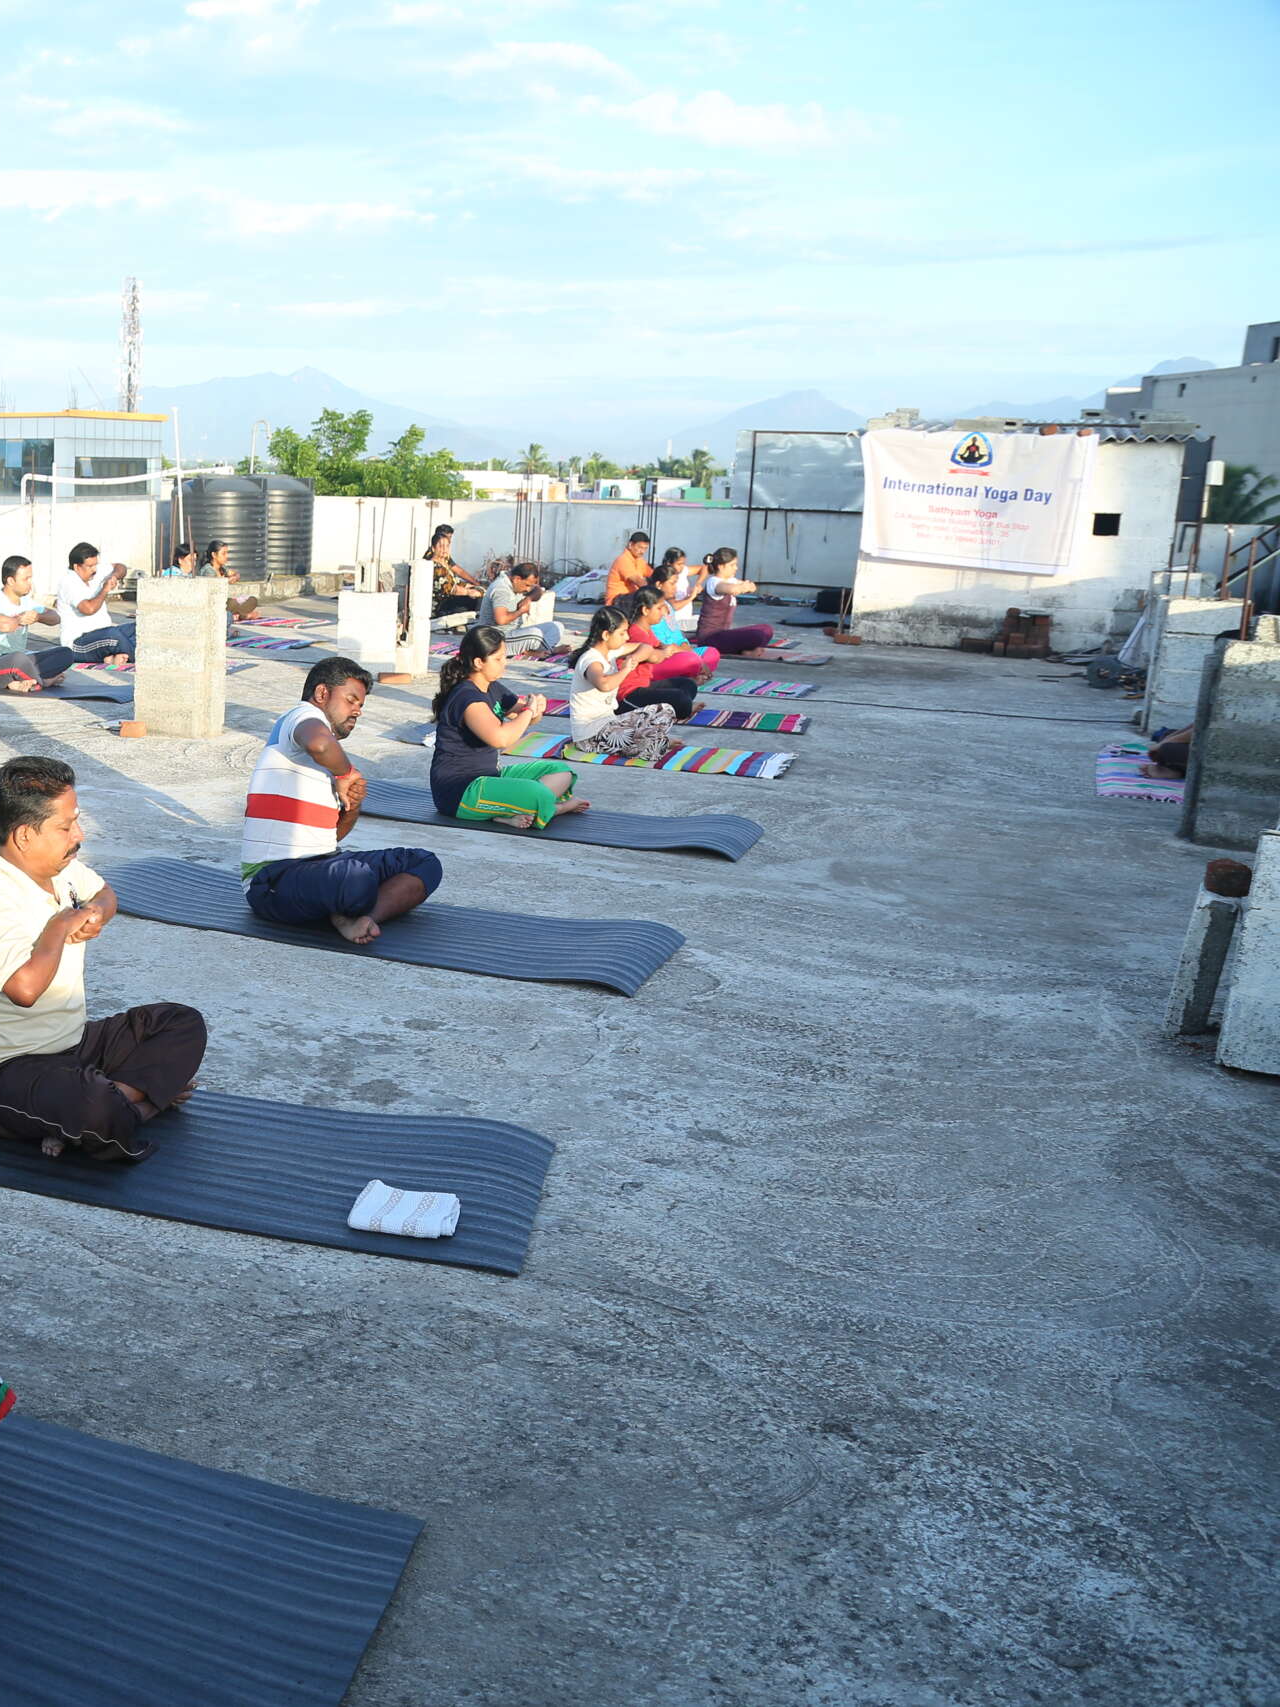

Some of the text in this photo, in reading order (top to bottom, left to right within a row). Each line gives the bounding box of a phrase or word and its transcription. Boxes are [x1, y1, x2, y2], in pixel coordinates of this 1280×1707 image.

[883, 477, 1053, 506] International Yoga Day
[928, 504, 971, 519] Sathyam
[973, 505, 998, 520] Yoga
